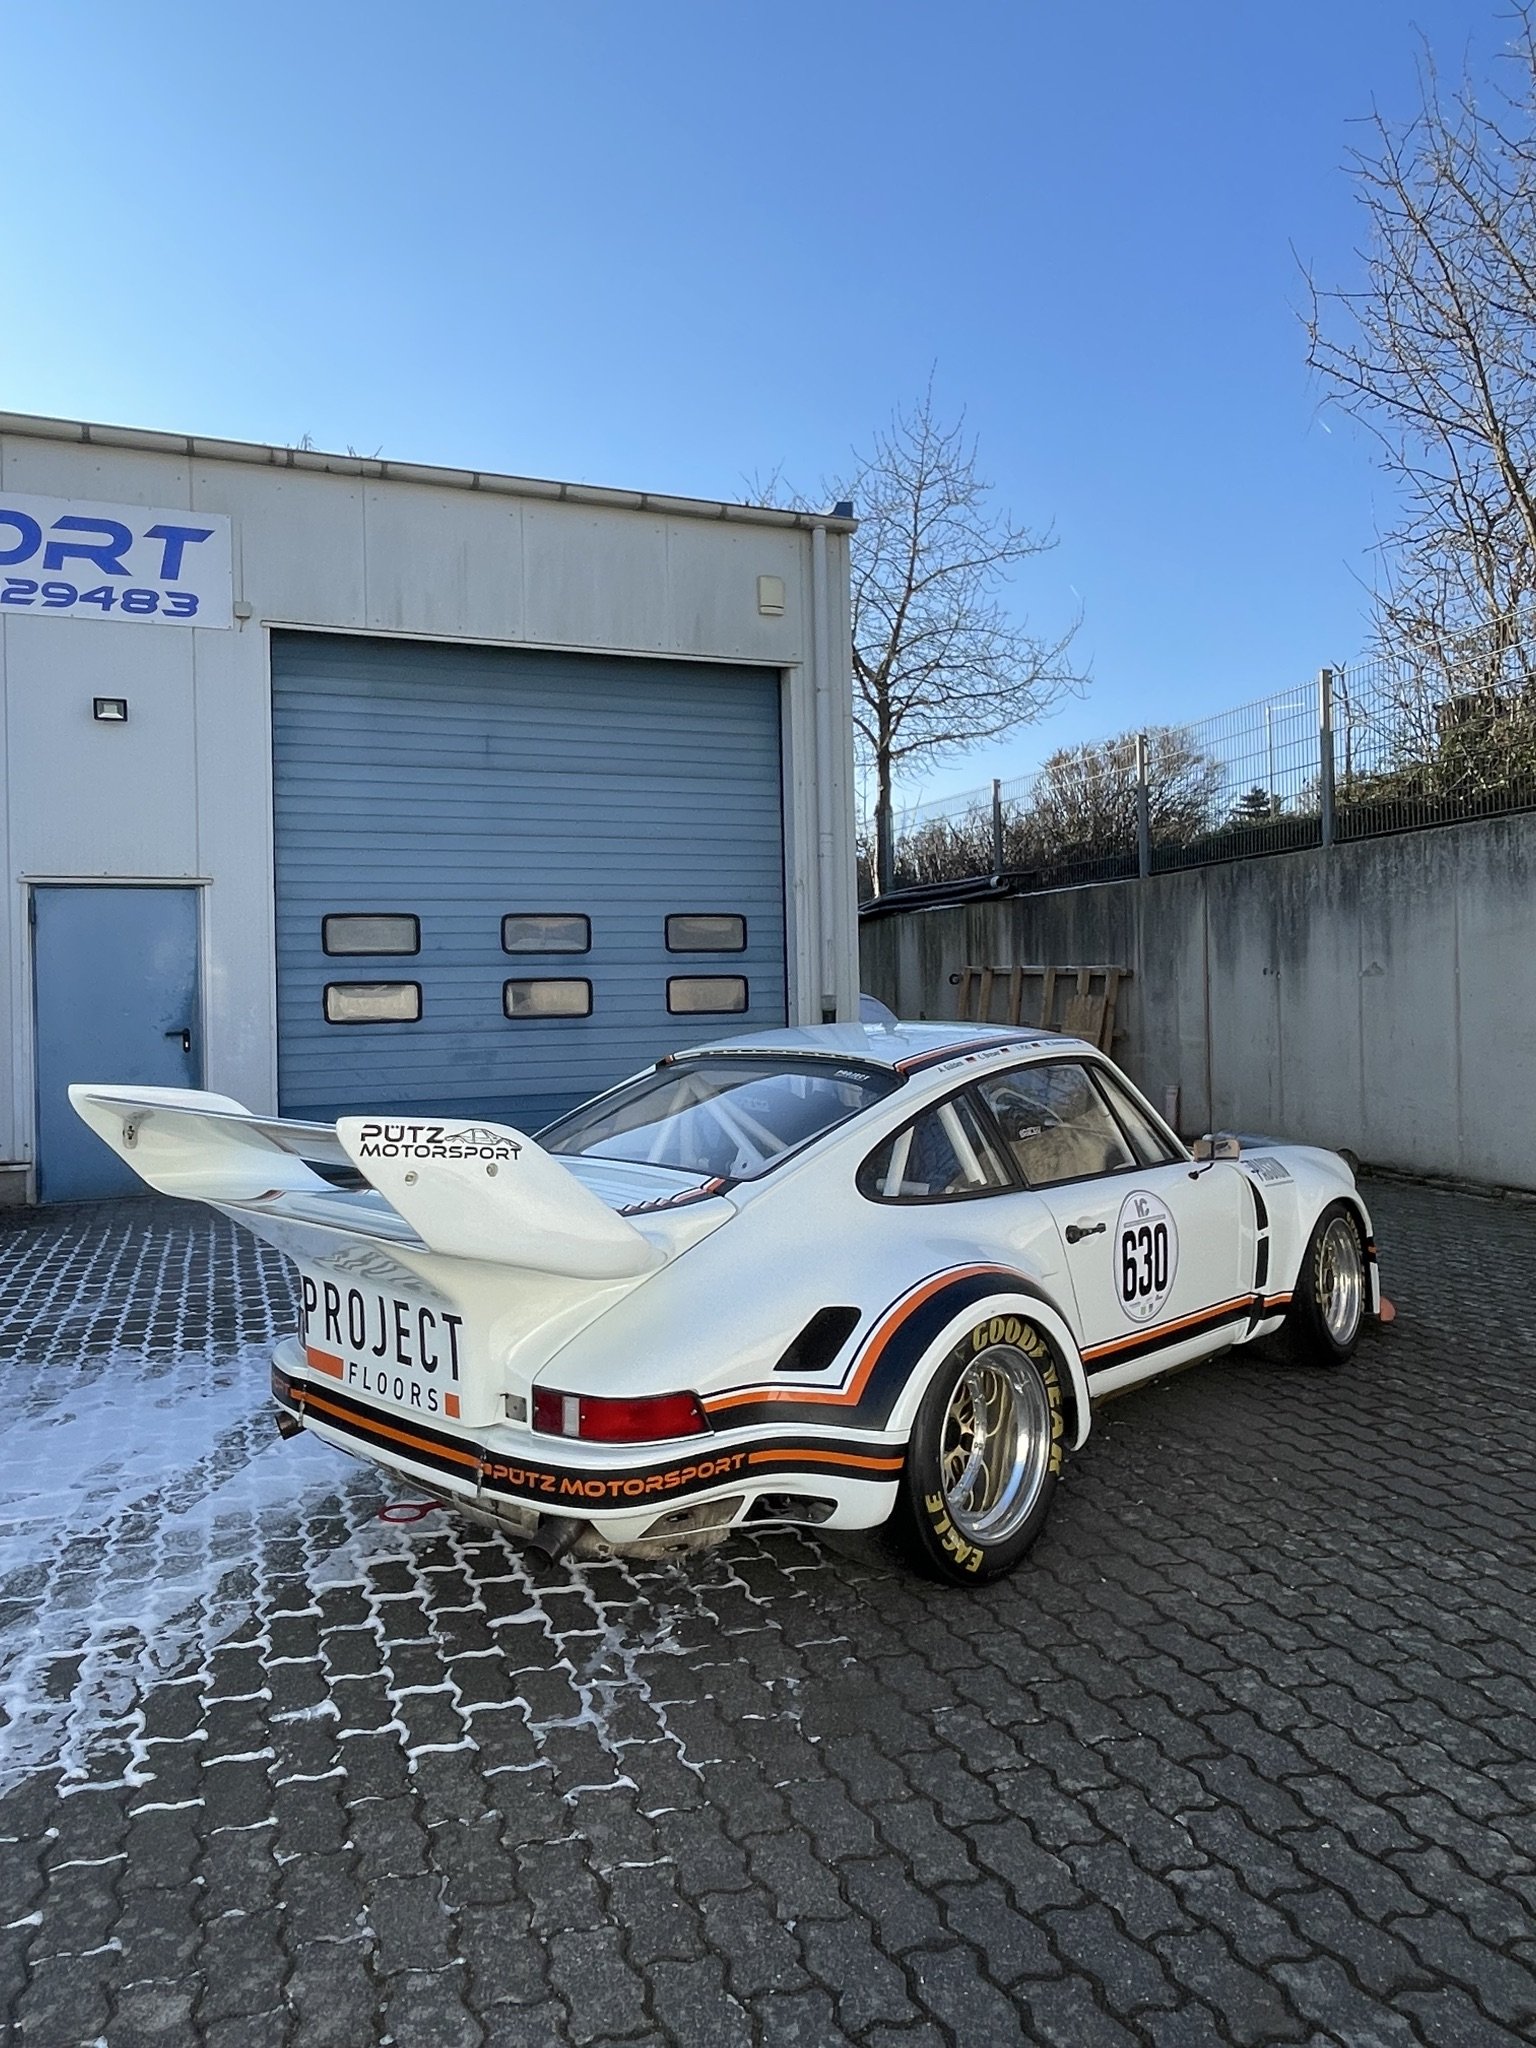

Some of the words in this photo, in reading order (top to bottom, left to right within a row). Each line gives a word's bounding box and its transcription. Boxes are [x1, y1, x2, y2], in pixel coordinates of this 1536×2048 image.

[1, 578, 199, 618] 29483
[359, 1143, 522, 1160] MOTORSPORT
[360, 1124, 445, 1144] PÜTZ
[1122, 1223, 1168, 1302] 630
[302, 1275, 462, 1381] PROJECT
[349, 1362, 438, 1412] FLOORS
[493, 1464, 556, 1493] PÜTZ
[560, 1452, 745, 1498] MOTORSPORT
[925, 1491, 984, 1574] EAGLE
